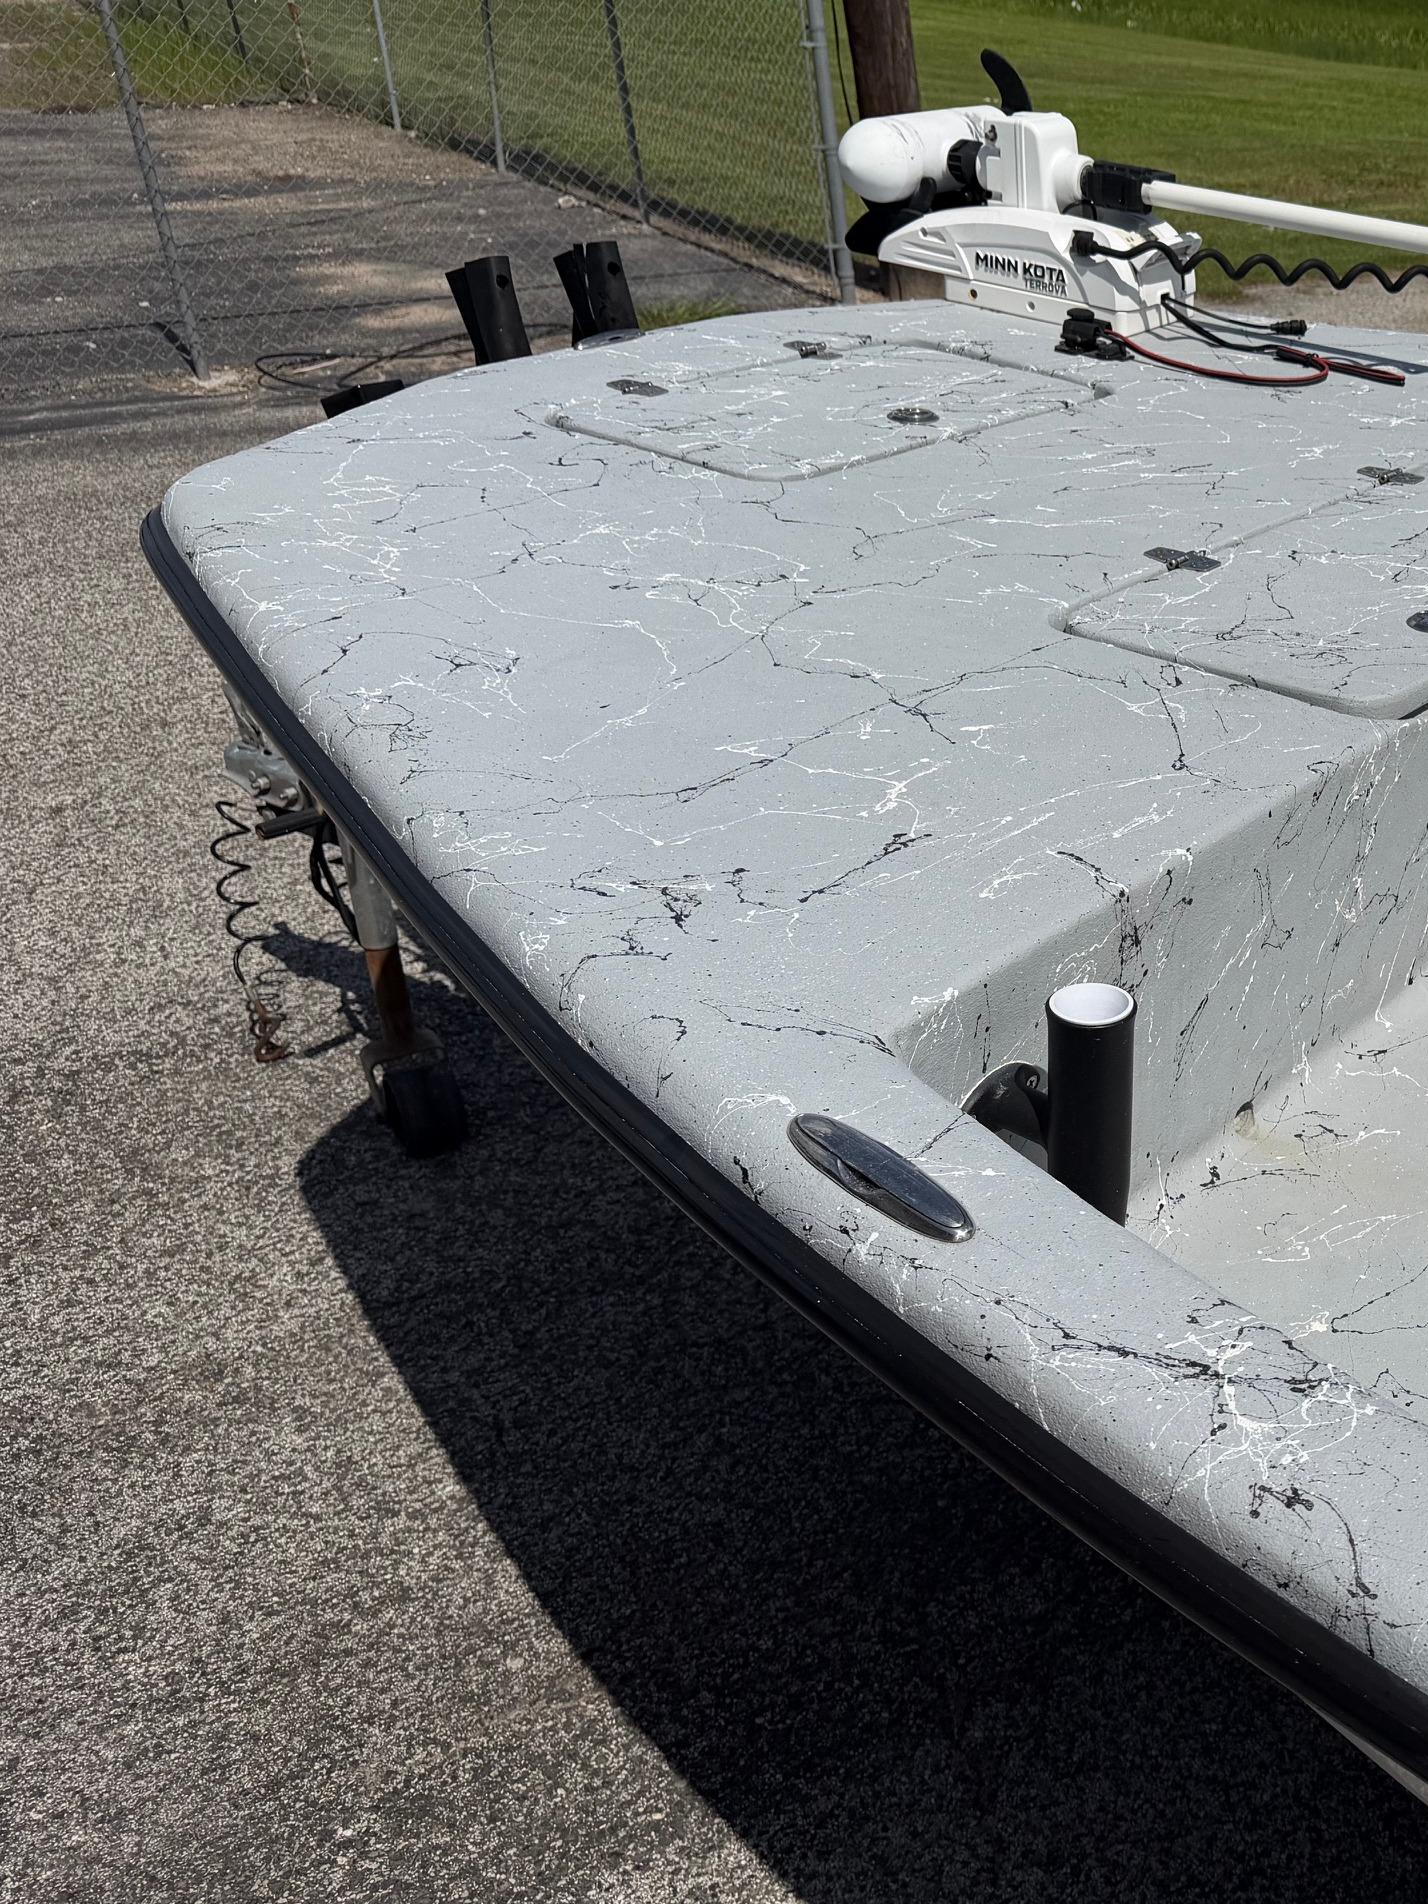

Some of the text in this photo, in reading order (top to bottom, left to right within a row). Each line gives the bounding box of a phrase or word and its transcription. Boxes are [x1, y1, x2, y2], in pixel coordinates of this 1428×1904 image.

[975, 251, 1066, 284] MINN KOTA
[1024, 279, 1068, 297] TERROVA
